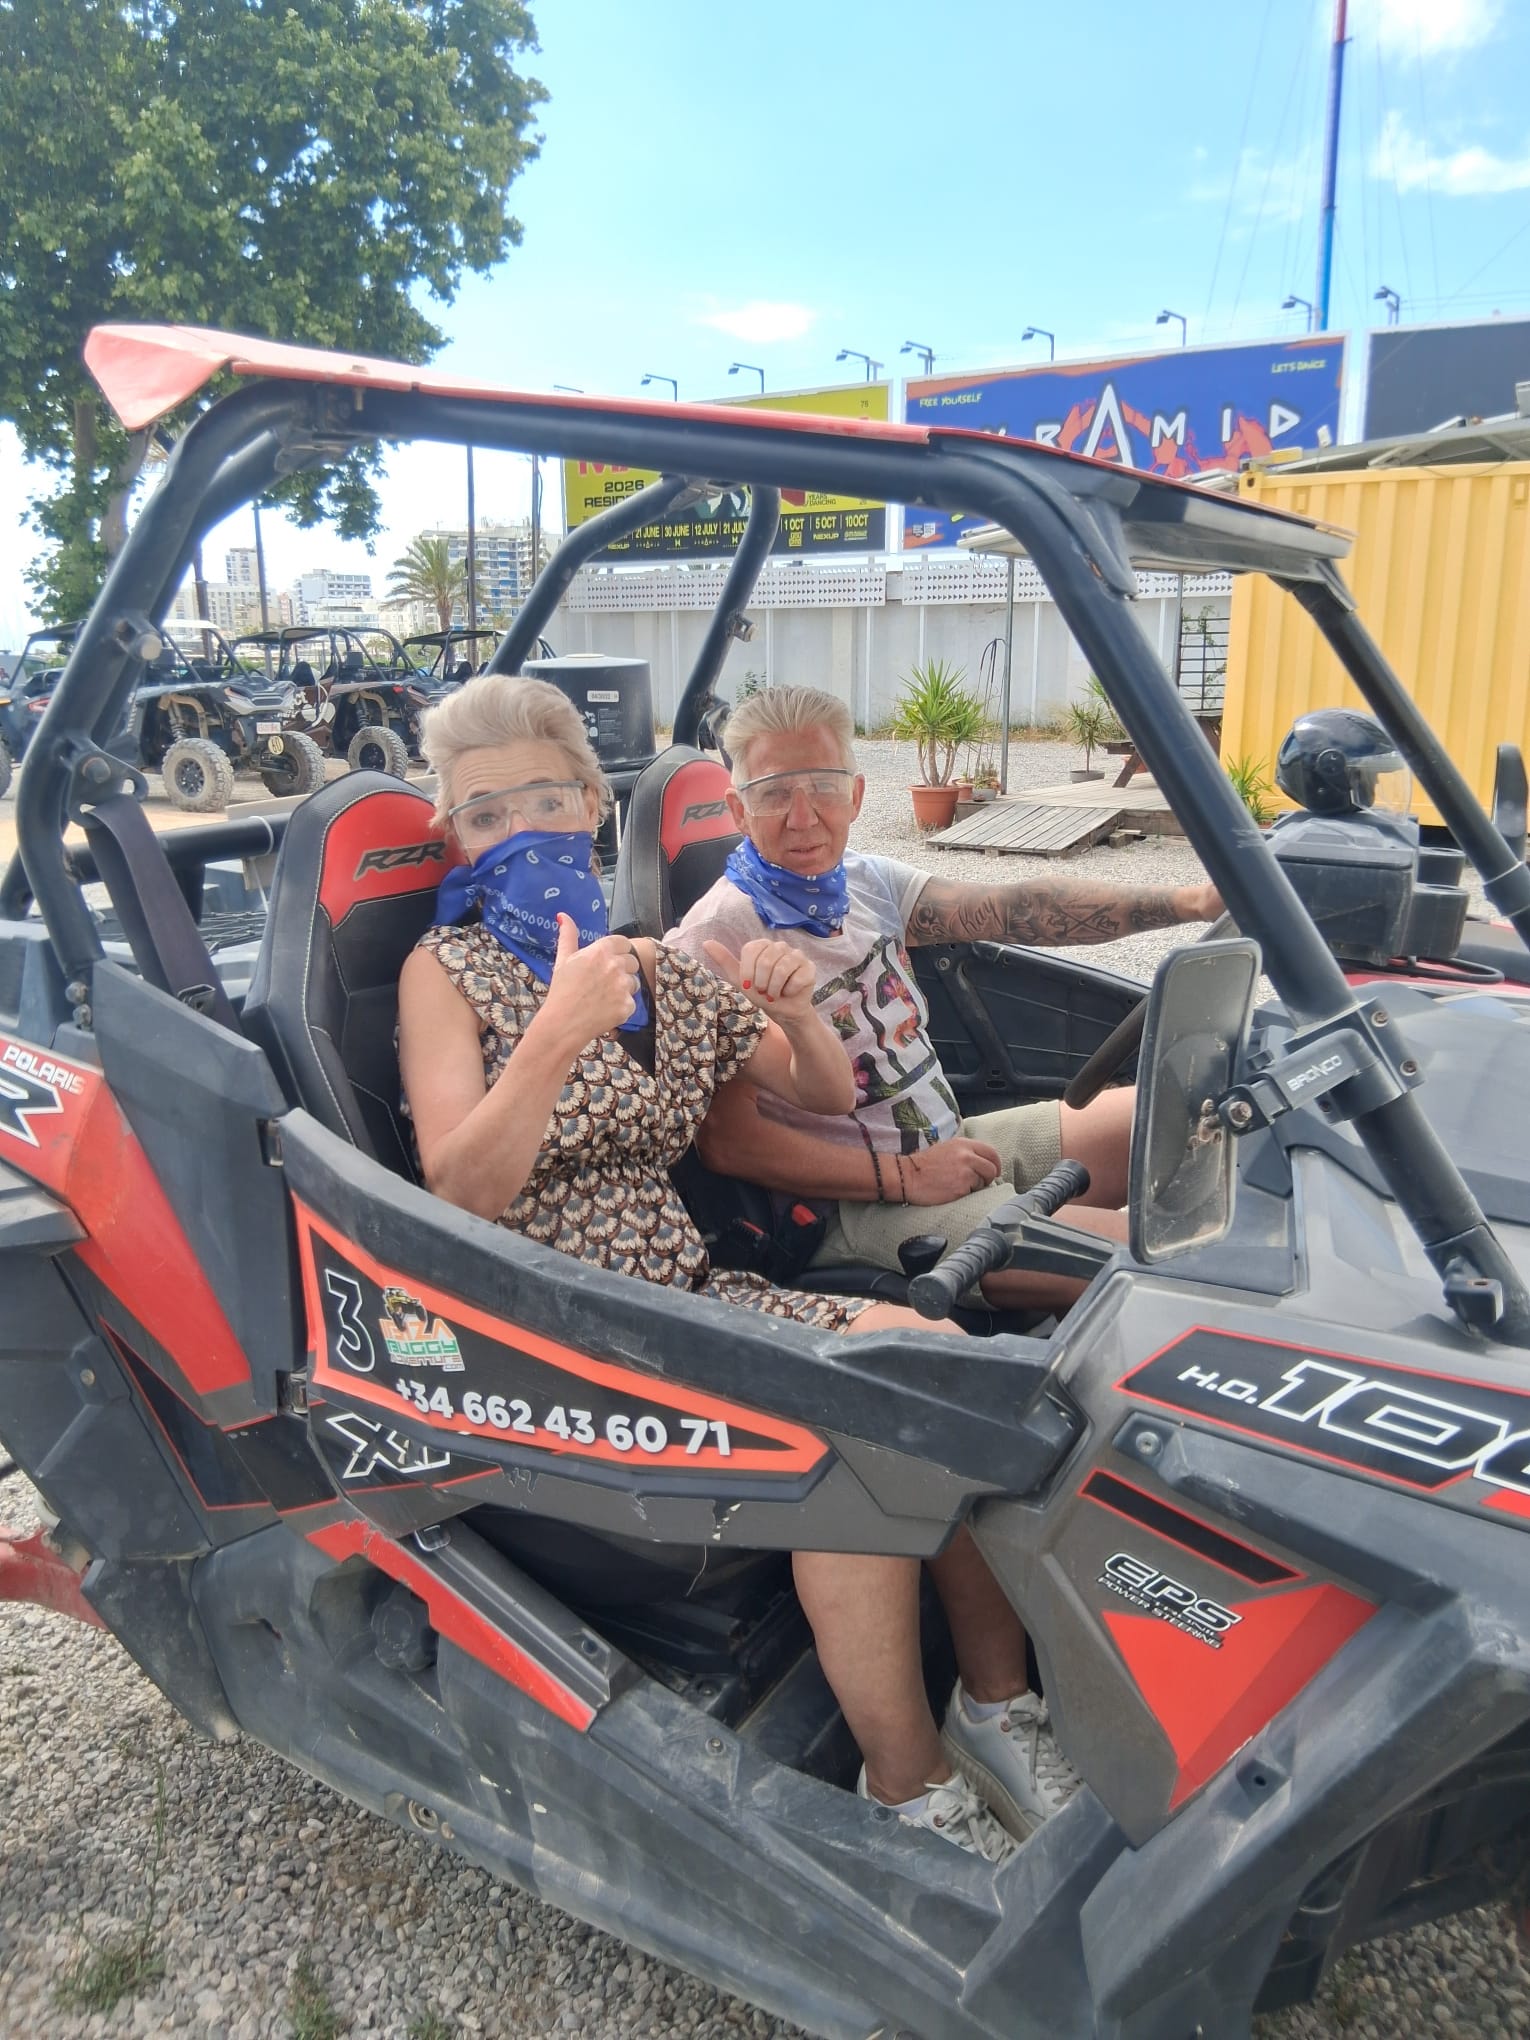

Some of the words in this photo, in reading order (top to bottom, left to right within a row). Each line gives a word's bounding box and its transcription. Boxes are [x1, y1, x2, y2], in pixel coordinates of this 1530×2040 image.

[919, 397, 938, 408] FREE
[941, 393, 983, 407] YOURSELF
[604, 480, 645, 493] 2026
[635, 527, 642, 539] 21
[643, 525, 660, 538] JUNE
[664, 525, 673, 538] 30
[673, 523, 690, 537] JUNE
[695, 523, 702, 536] 12
[702, 522, 718, 536] JULY
[723, 522, 731, 535] 21
[789, 518, 805, 531] OCT
[821, 516, 837, 529] OCT
[853, 514, 869, 527] OCT
[353, 840, 448, 881] RZR
[2, 1044, 86, 1096] POLARIS
[1286, 1055, 1343, 1092] BRONCO
[324, 1268, 376, 1373] 3
[386, 1339, 459, 1355] BUGGY
[1177, 1365, 1258, 1405] H.O.
[395, 1378, 454, 1419] +34
[463, 1391, 536, 1434] 662
[544, 1405, 596, 1445] 43
[606, 1414, 668, 1454] 60
[681, 1418, 731, 1457] 71
[1104, 1552, 1243, 1632] EPS
[1097, 1576, 1151, 1609] POWER
[1151, 1607, 1222, 1649] STEERING
